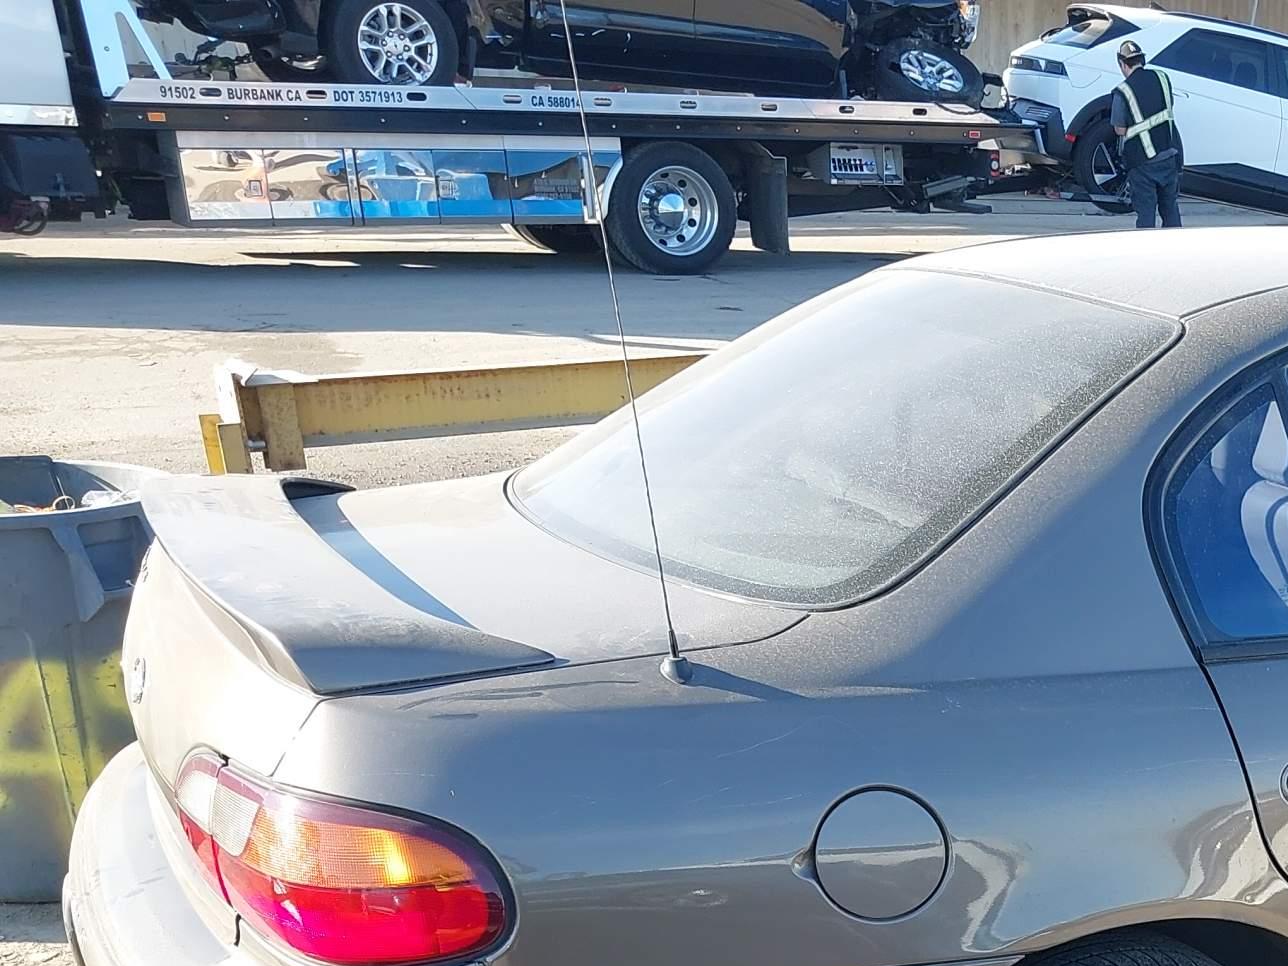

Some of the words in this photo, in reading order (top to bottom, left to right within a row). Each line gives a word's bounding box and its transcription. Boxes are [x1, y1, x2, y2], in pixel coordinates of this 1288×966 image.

[159, 85, 196, 99] 91502
[227, 87, 283, 101] BURBANK
[286, 89, 302, 101] CA
[333, 90, 355, 102] DOT
[359, 91, 403, 103] 3571913
[531, 95, 545, 107] CA
